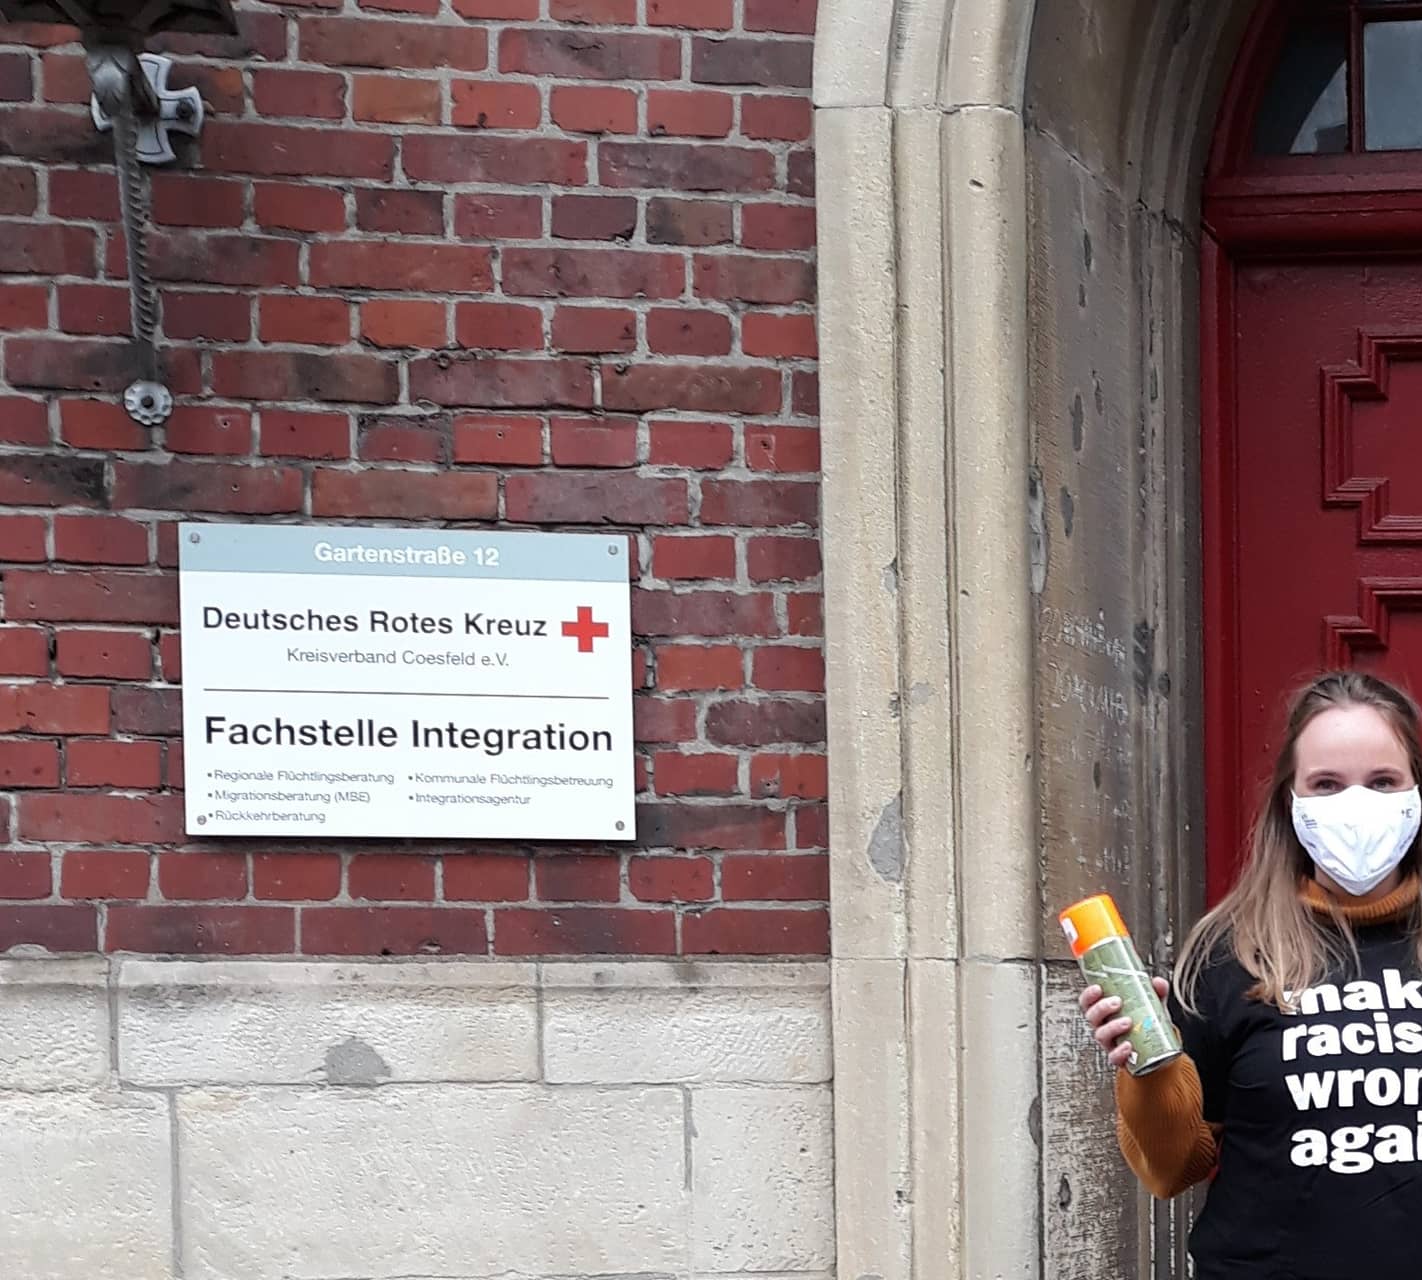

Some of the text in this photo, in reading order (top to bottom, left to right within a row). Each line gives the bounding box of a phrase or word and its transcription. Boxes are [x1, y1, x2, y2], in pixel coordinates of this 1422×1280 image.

[314, 543, 500, 567] Gartenstraße 12
[202, 607, 548, 637] Deutsches Rotes Kreuz
[287, 648, 510, 667] Kreisverband Coesfeld e.V.
[205, 715, 613, 756] Fachstelle Integration
[214, 769, 395, 785] Regionale Flüchtlingsberatung
[415, 773, 614, 789] Kommunale Flüchtlingsbetreuung
[214, 790, 331, 804] Migrationsberatung
[415, 792, 531, 806] Integrationsagentur
[215, 810, 326, 824] Rückkehrberatung
